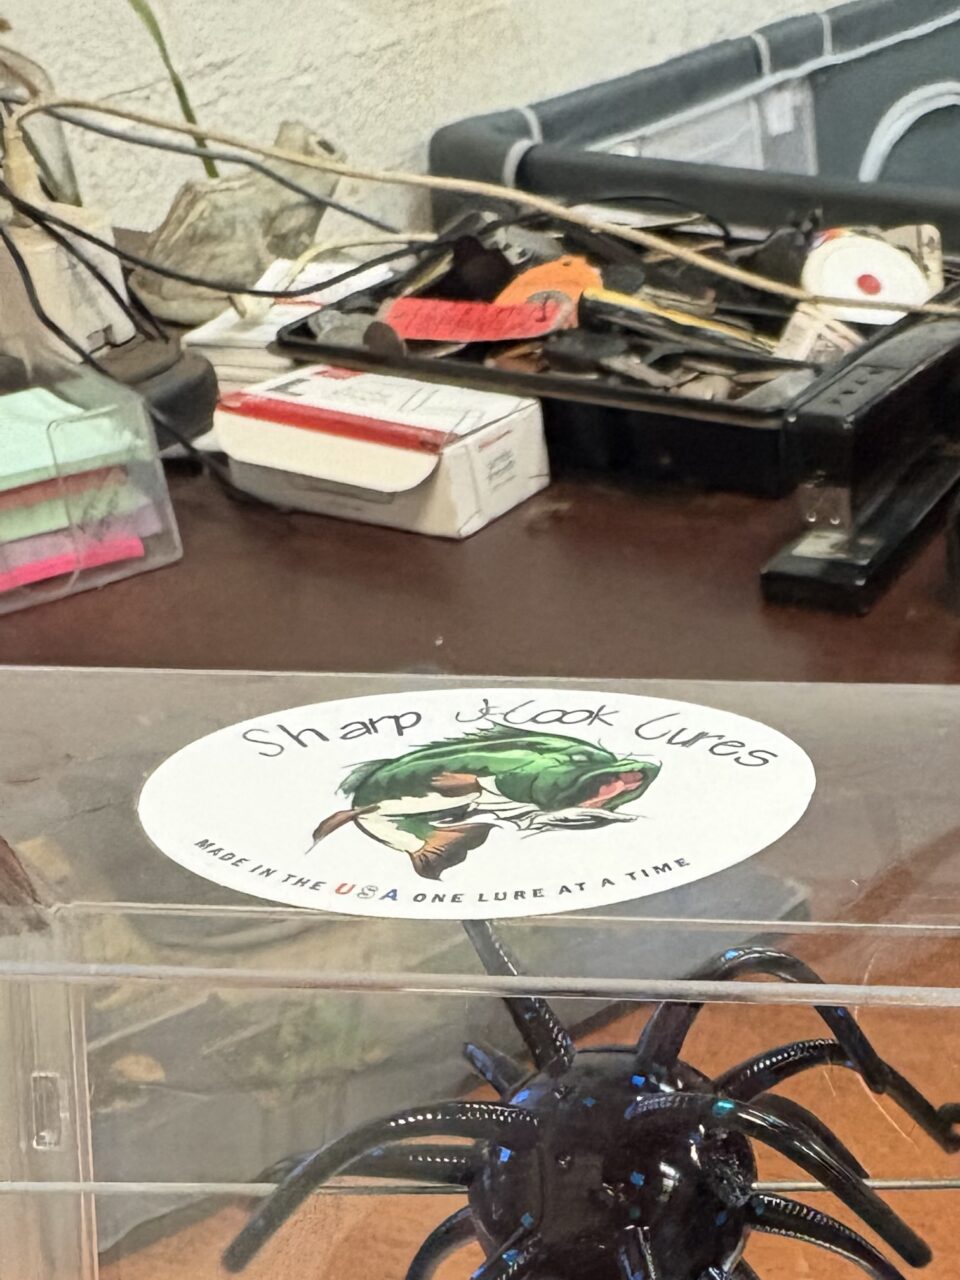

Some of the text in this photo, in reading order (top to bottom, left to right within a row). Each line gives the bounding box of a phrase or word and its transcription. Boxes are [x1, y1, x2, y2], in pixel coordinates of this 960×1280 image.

[242, 710, 422, 757] Sharp
[193, 838, 691, 903] MADE IN THE USA ONE LURE AT A TIME
